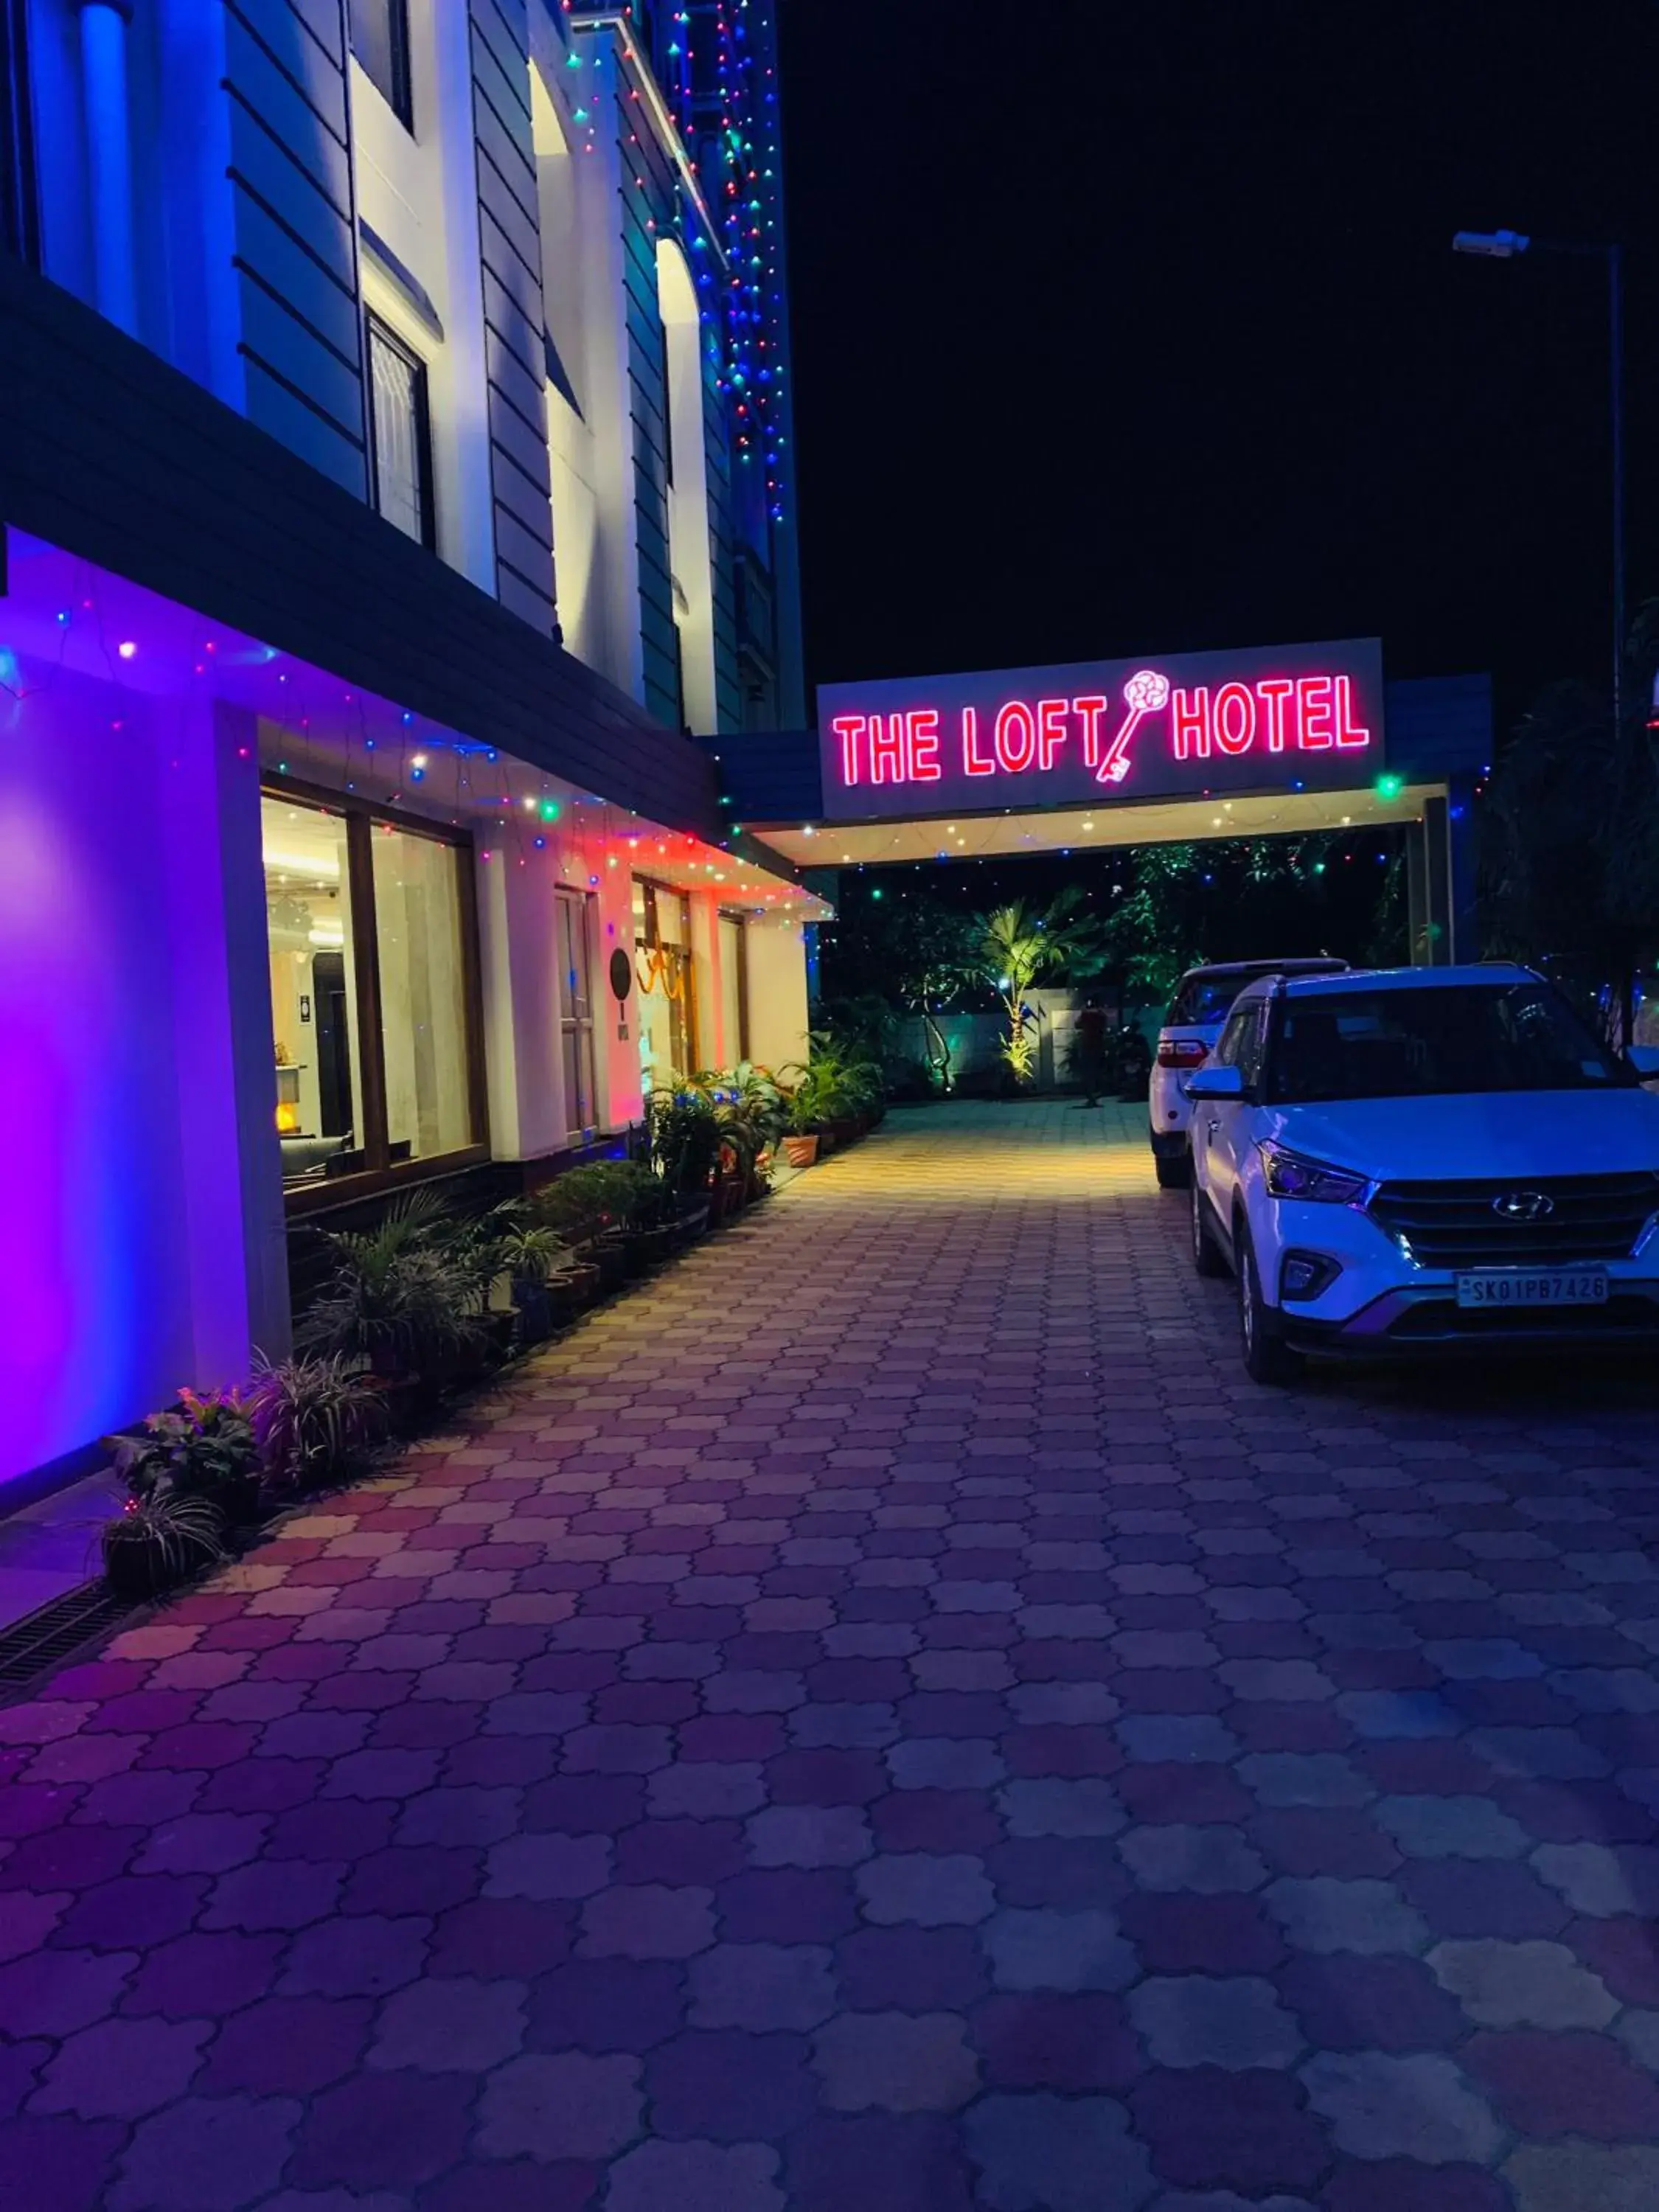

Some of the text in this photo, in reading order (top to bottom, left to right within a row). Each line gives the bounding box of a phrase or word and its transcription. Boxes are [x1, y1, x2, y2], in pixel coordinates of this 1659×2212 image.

[834, 675, 1370, 785] THE LOFT HOTEL
